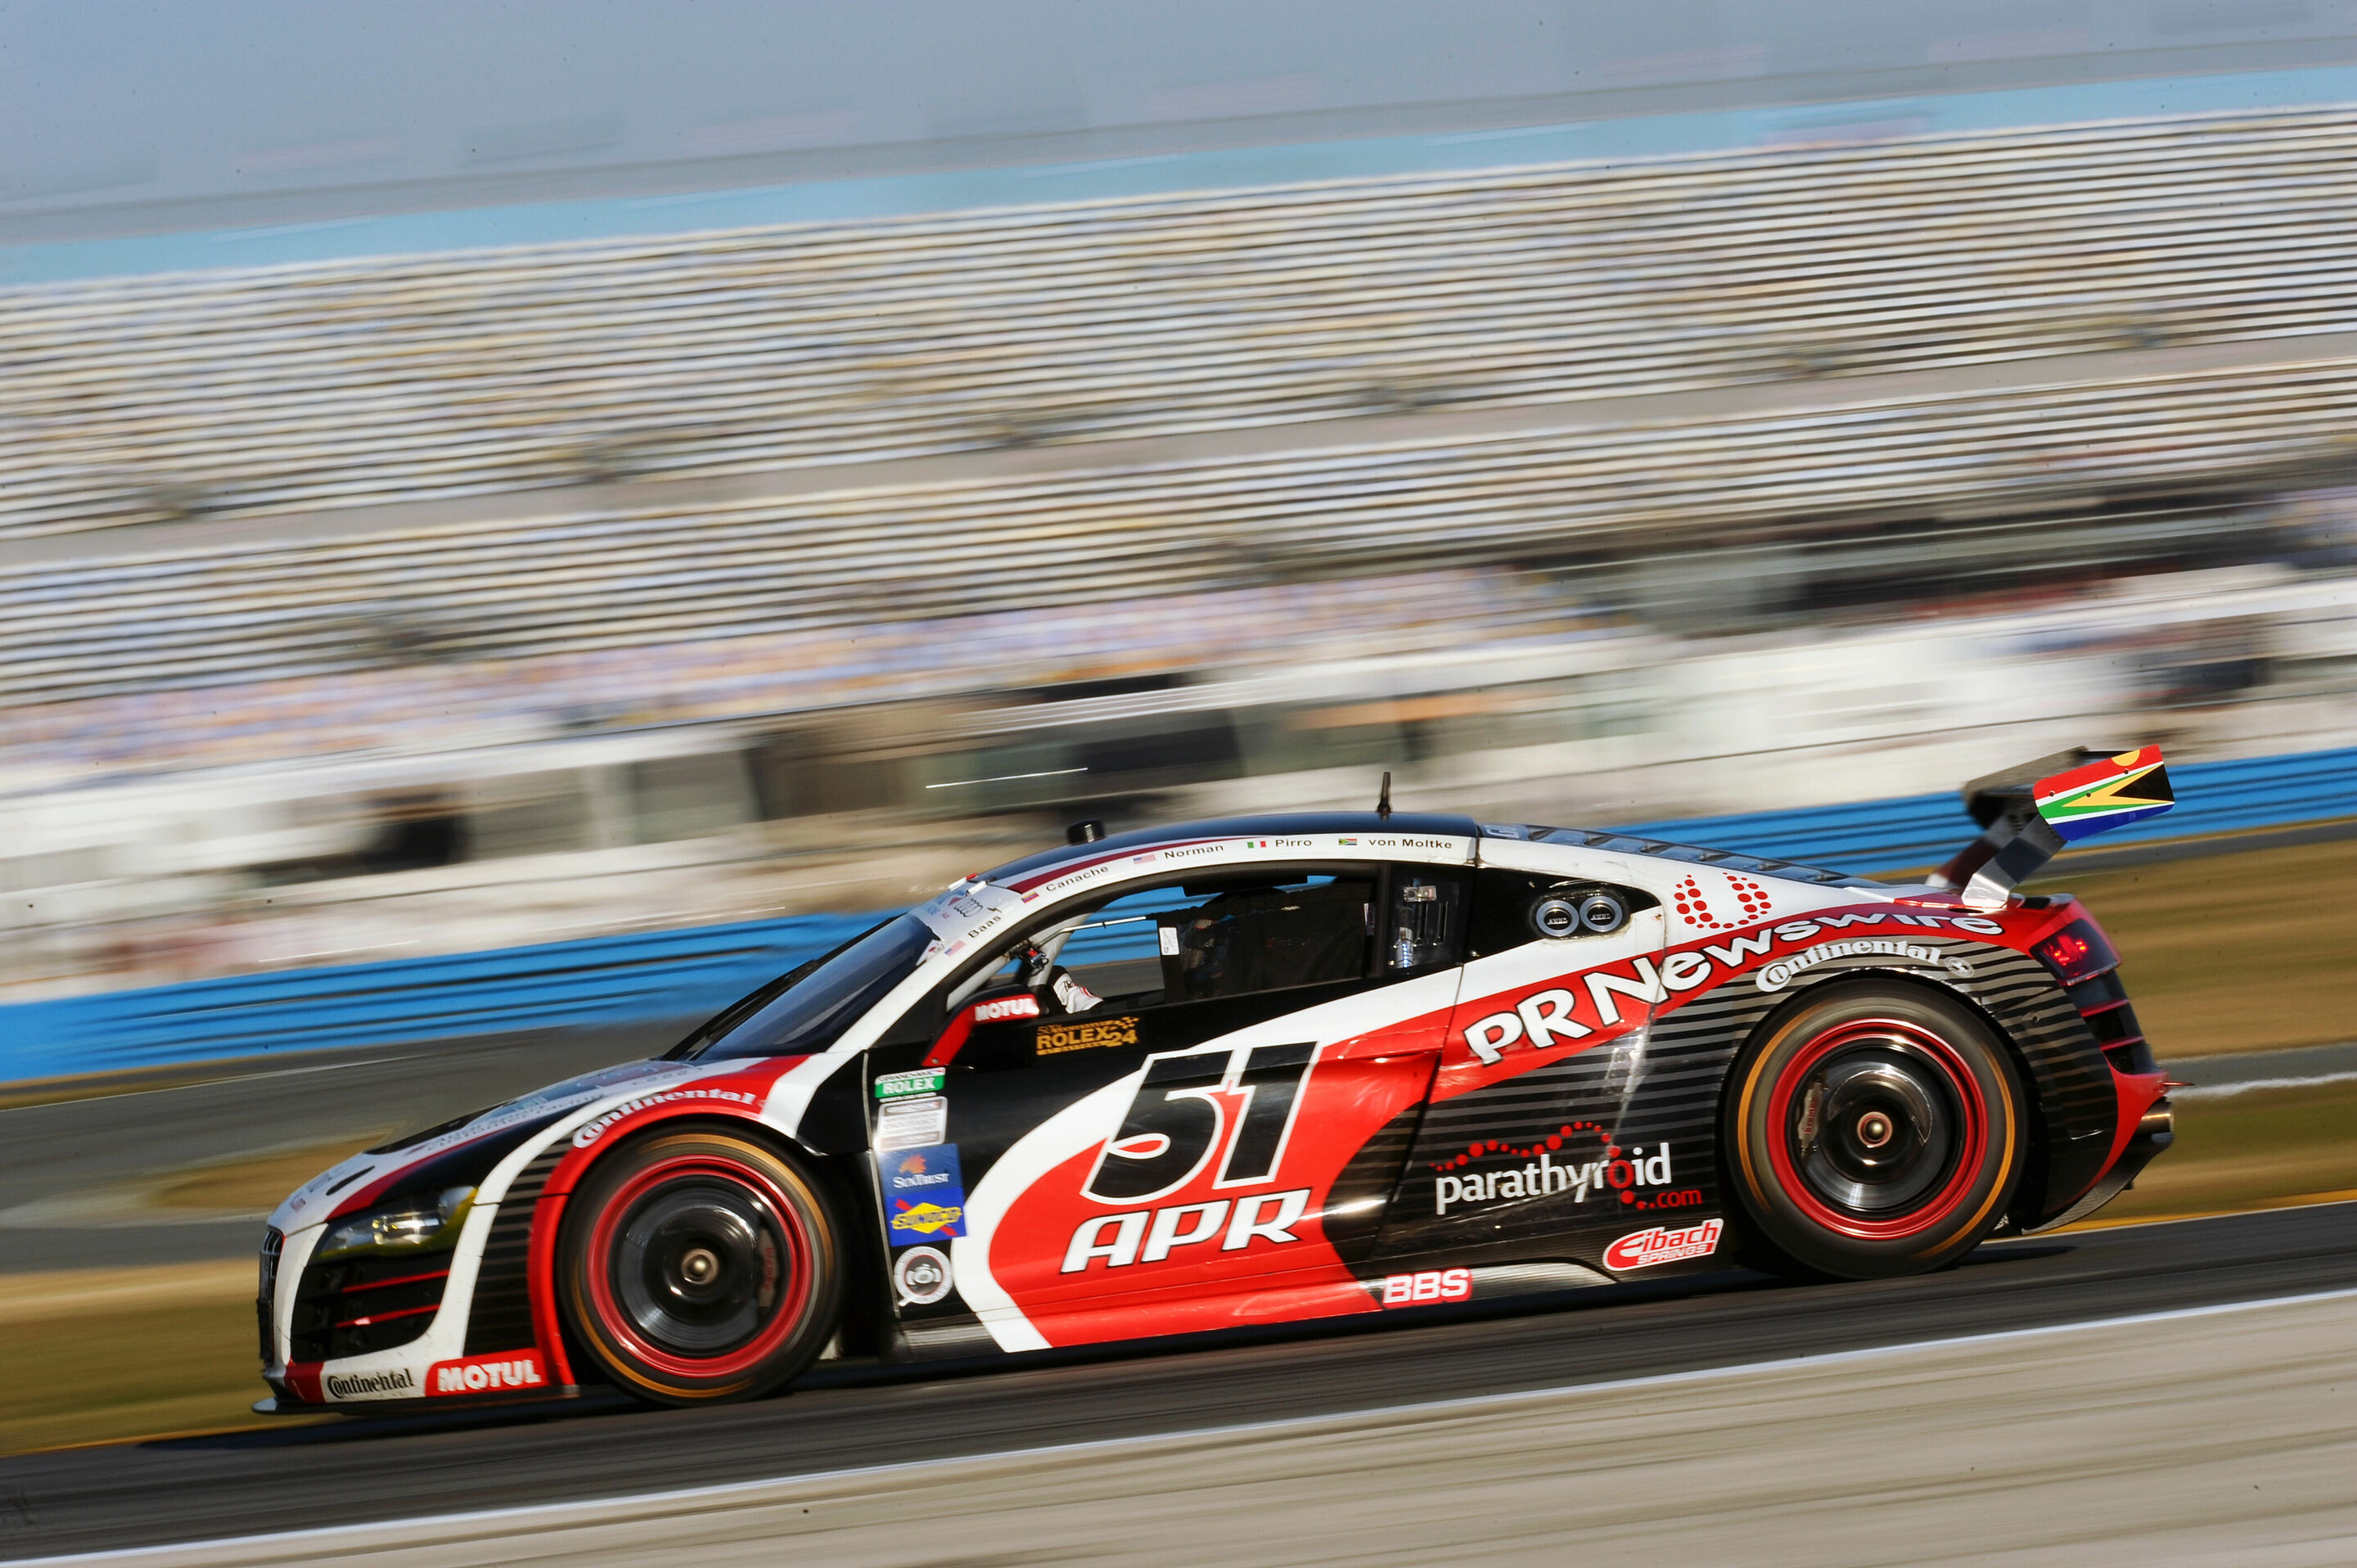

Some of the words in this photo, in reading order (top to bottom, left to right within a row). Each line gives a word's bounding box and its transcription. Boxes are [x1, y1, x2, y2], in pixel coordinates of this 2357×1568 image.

[1165, 843, 1224, 860] Norman
[1275, 838, 1313, 848] Pirro
[1368, 840, 1396, 848] von
[1402, 838, 1453, 849] Moltke
[1046, 865, 1109, 893] Canache
[967, 915, 1002, 939] Baas
[1755, 940, 1942, 993] Continental
[975, 997, 1039, 1021] MOTUL
[1036, 1025, 1109, 1050] ROLEX
[1105, 1029, 1140, 1048] 24
[882, 1077, 936, 1095] ROLEX
[572, 1088, 757, 1149] Continental
[1079, 1040, 1323, 1205] 51
[1435, 1142, 1672, 1215] parathyroid
[1060, 1188, 1311, 1274] APR
[1607, 1221, 1719, 1268] Eibach
[1637, 1242, 1708, 1264] SPRINGS
[1381, 1268, 1471, 1304] BBS
[327, 1367, 415, 1399] Continental
[437, 1359, 542, 1392] MOTUL
